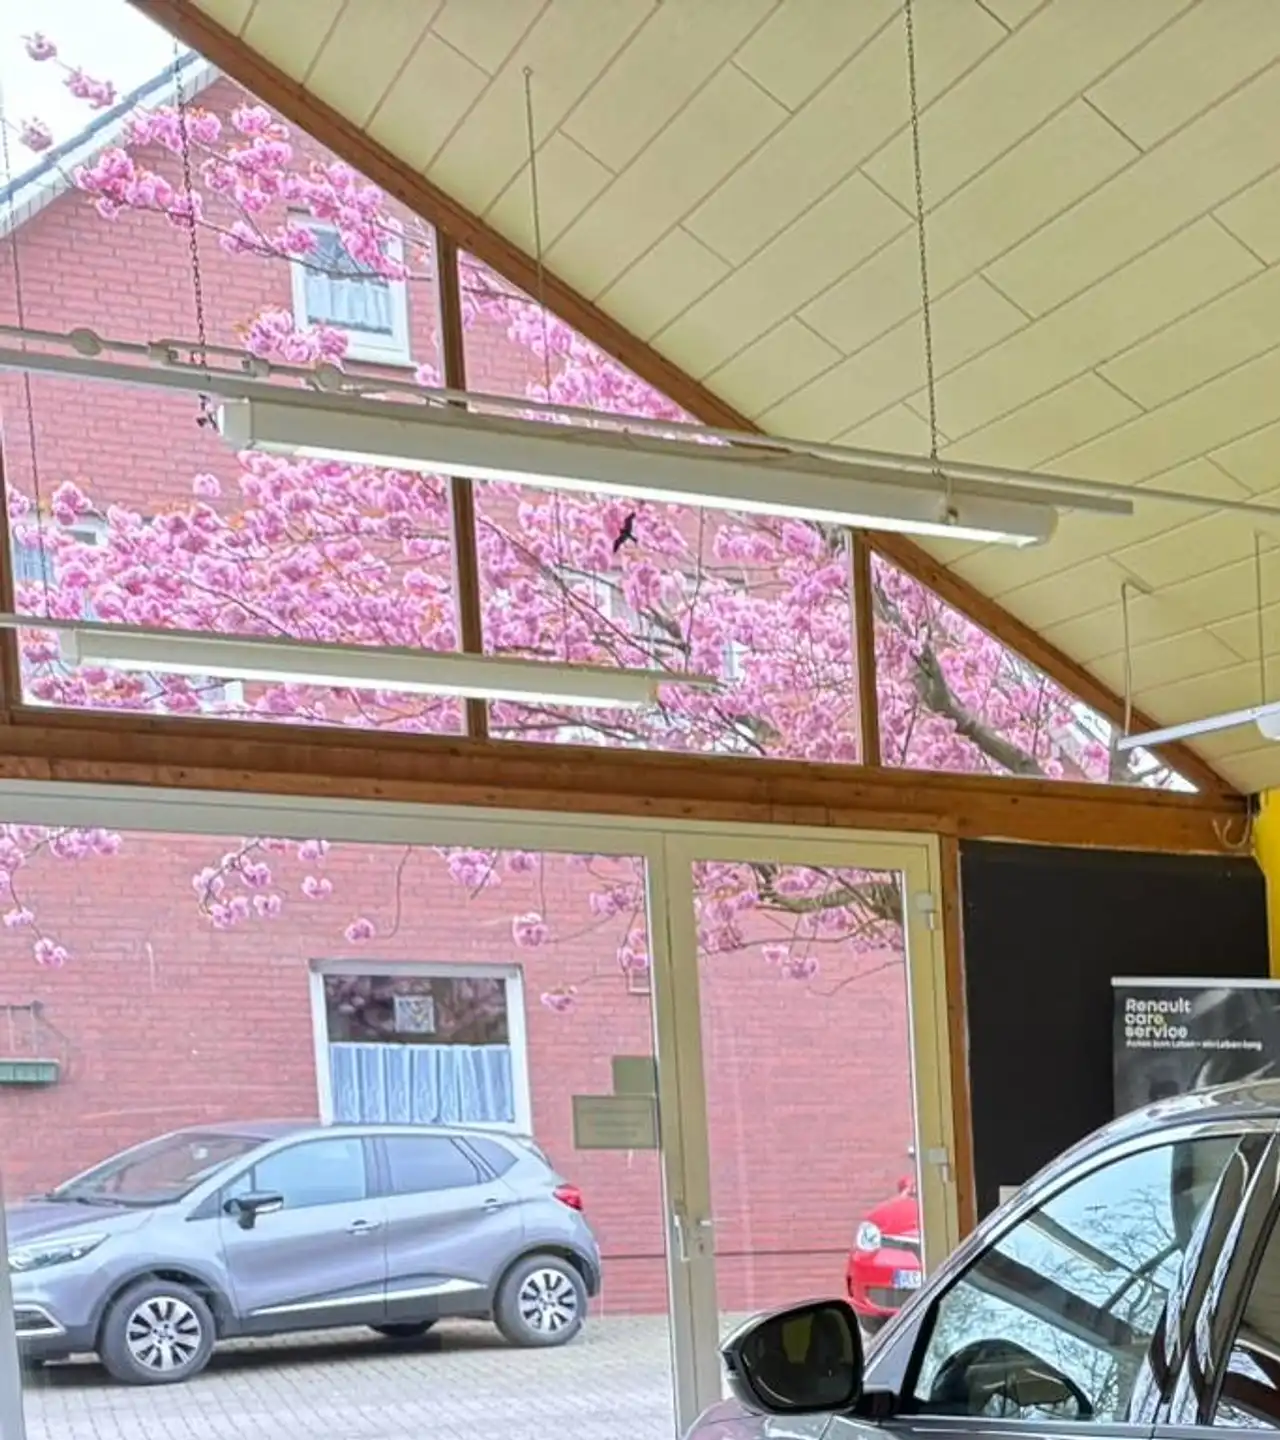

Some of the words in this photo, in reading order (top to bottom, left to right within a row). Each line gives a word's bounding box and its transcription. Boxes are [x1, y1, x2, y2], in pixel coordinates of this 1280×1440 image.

[1124, 997, 1192, 1014] Renault
[1124, 1012, 1165, 1026] care
[1124, 1025, 1189, 1039] service
